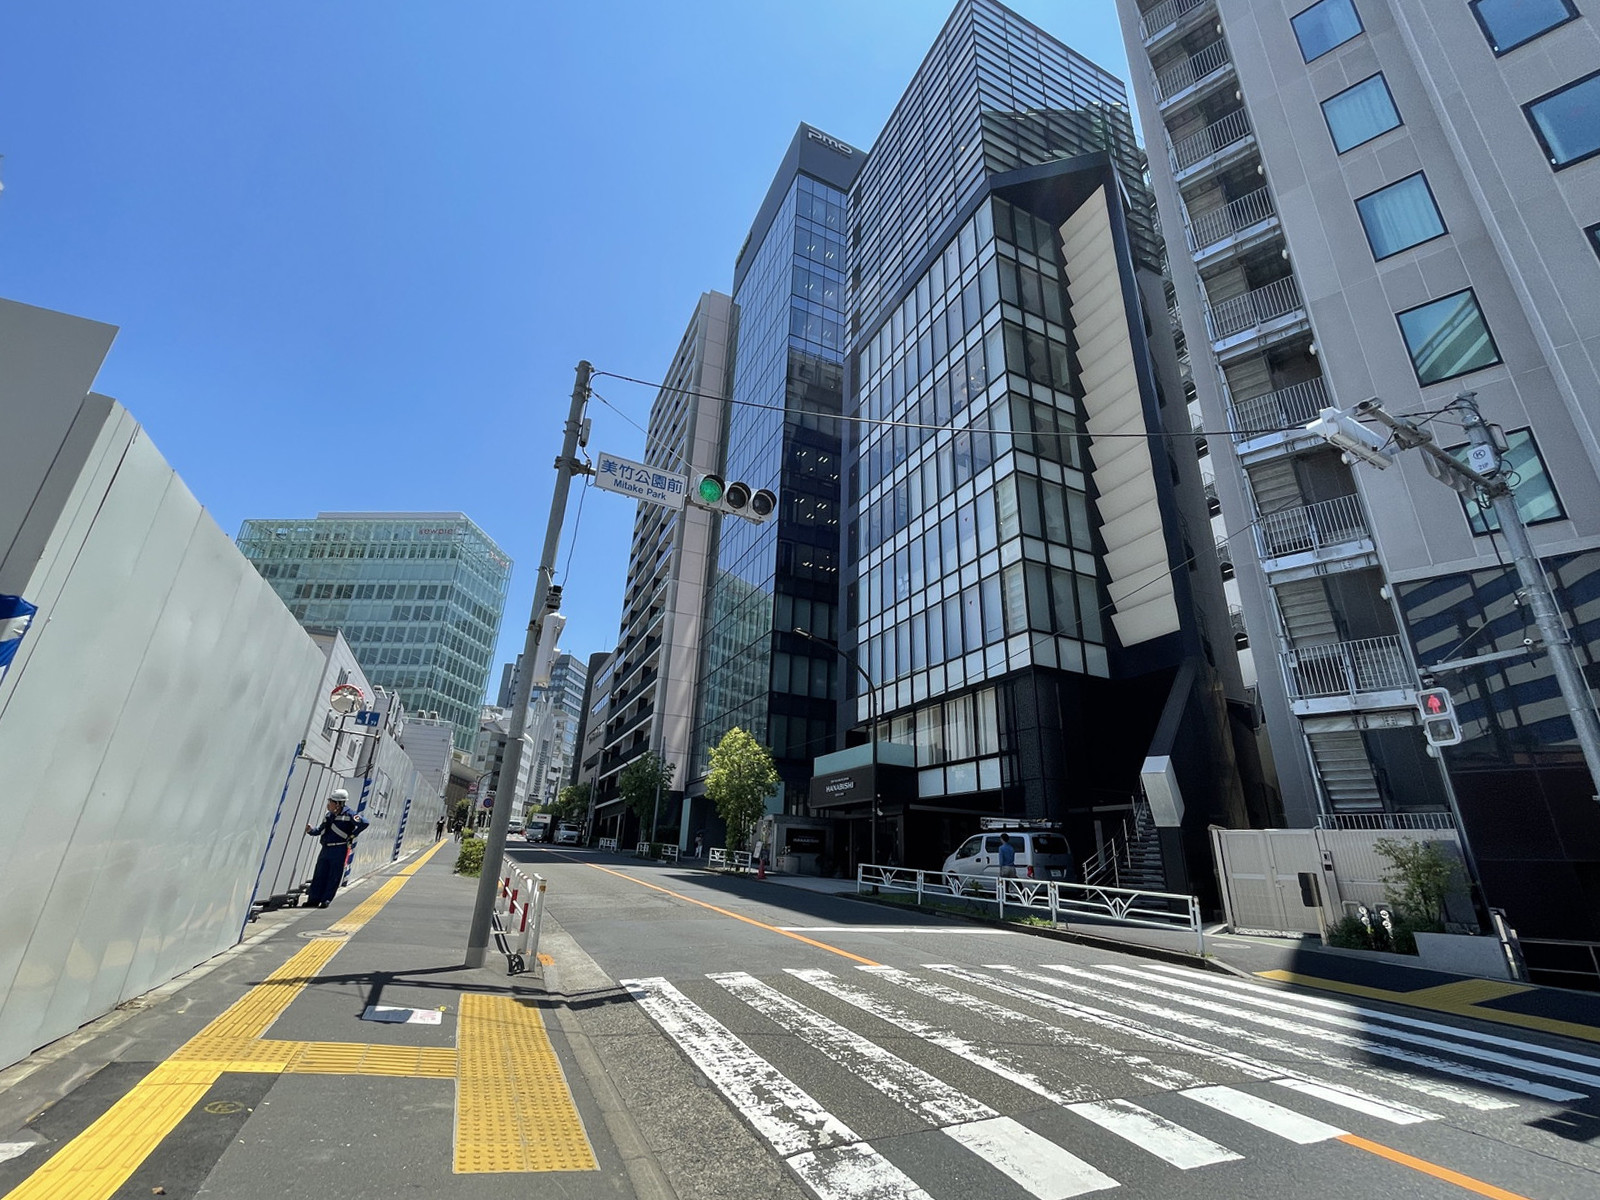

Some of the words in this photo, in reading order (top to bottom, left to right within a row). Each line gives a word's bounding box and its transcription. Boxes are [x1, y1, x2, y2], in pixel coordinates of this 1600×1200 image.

[600, 459, 684, 495] 美竹公園前
[613, 479, 643, 494] Mitake
[646, 485, 666, 501] Park
